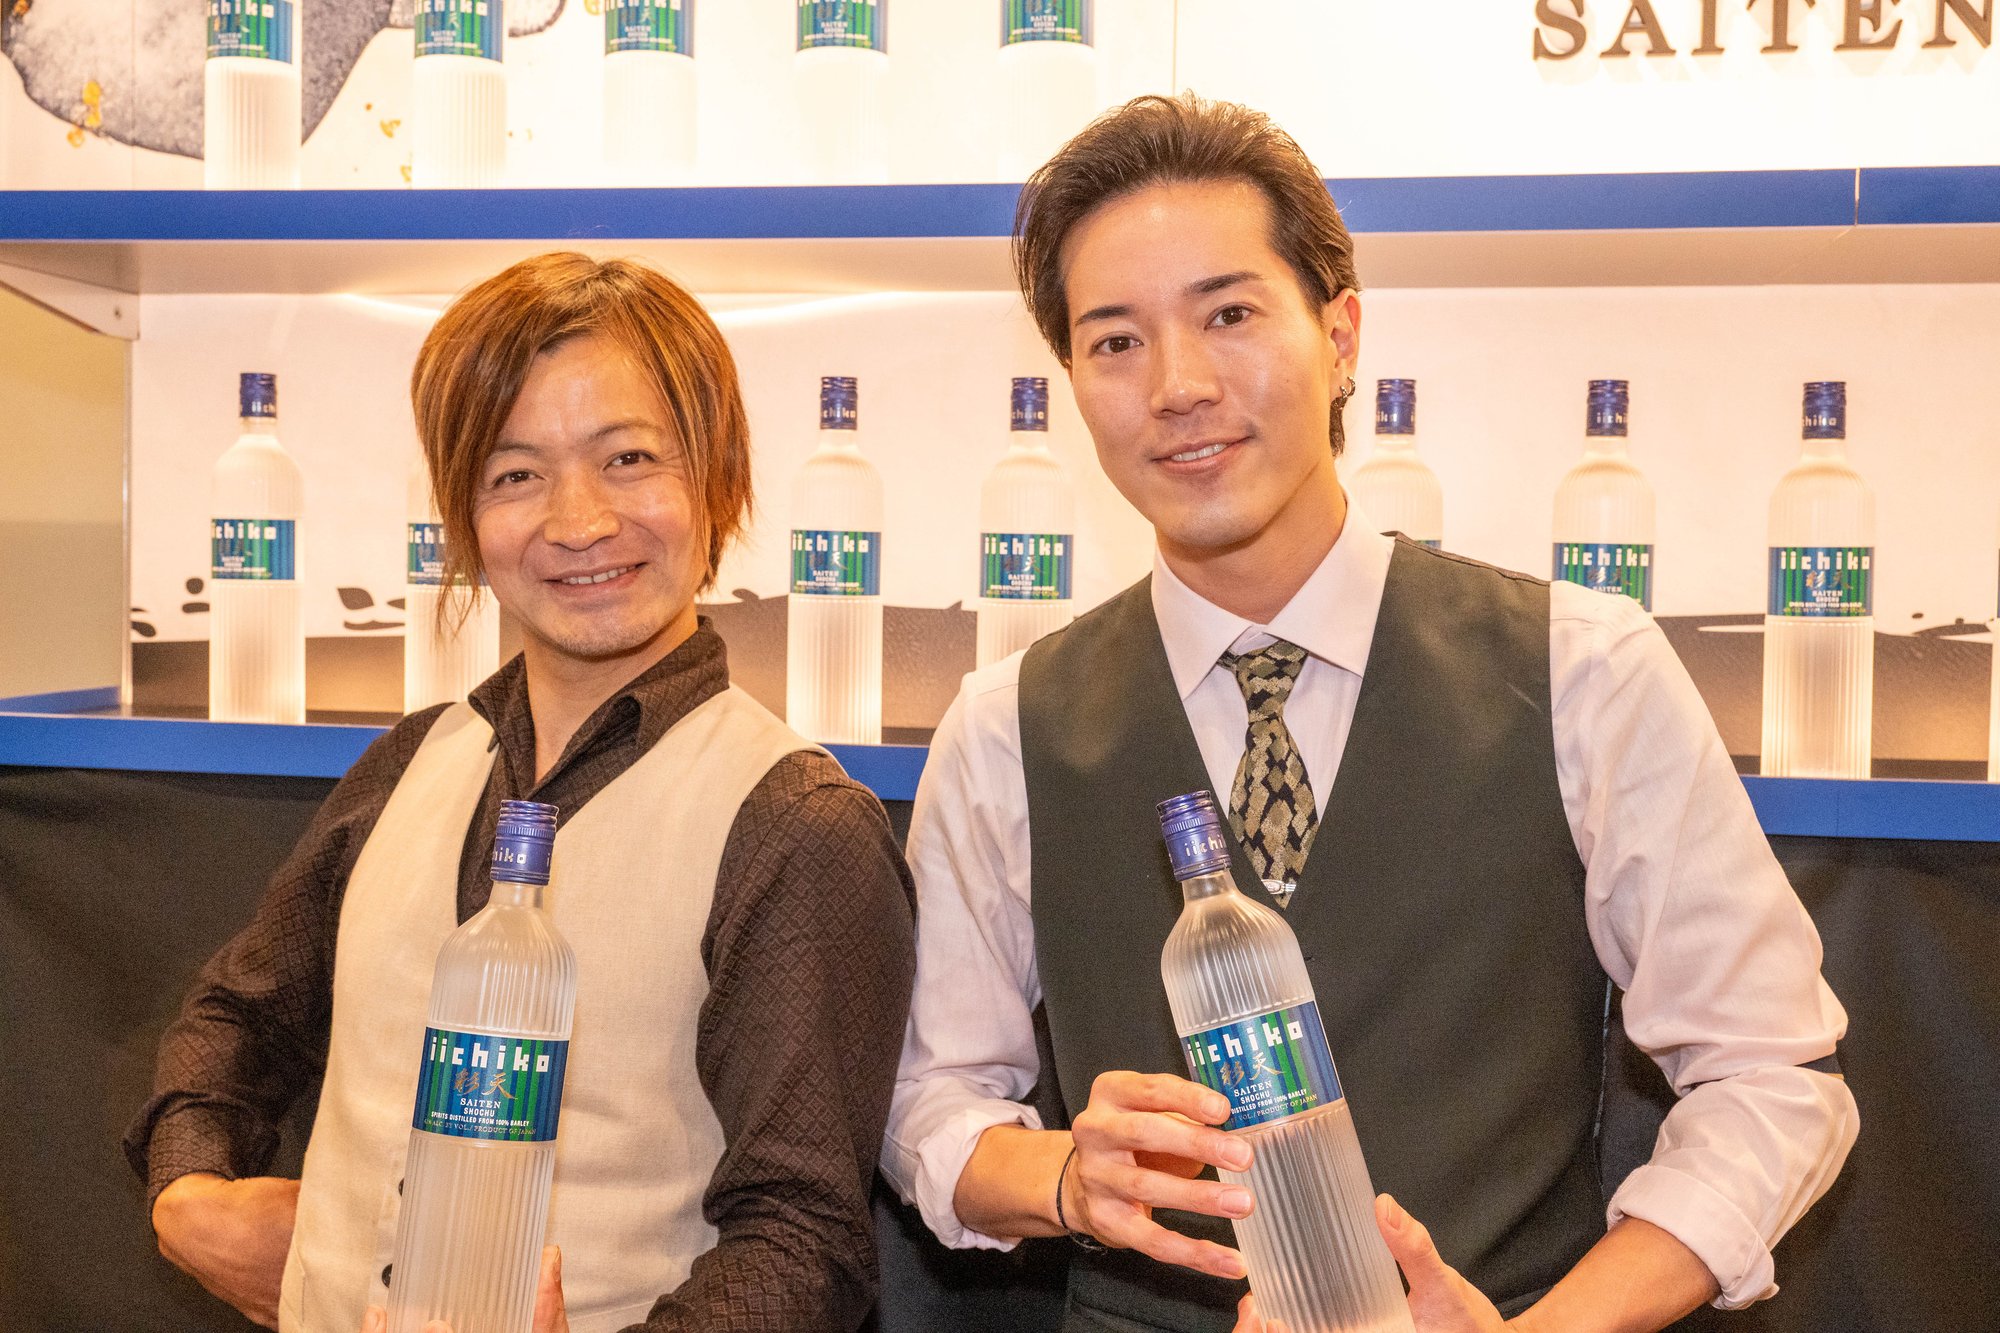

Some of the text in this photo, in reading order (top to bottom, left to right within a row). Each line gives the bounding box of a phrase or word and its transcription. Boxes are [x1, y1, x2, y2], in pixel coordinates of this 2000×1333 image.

[1532, 0, 1993, 61] SAITEN
[792, 534, 869, 553] iichiko
[984, 537, 1064, 556] iichiko
[1563, 547, 1649, 567] iichiko
[1780, 551, 1870, 570] iichiko
[1187, 1020, 1304, 1068] iichiko
[430, 1036, 550, 1072] iichiko
[1233, 1080, 1273, 1097] SAITEN
[1240, 1090, 1271, 1105] SHOCHU
[460, 1097, 502, 1109] SAITEN
[463, 1107, 495, 1117] SHOCHU
[1257, 1098, 1273, 1108] FROM
[478, 1117, 494, 1125] FROM
